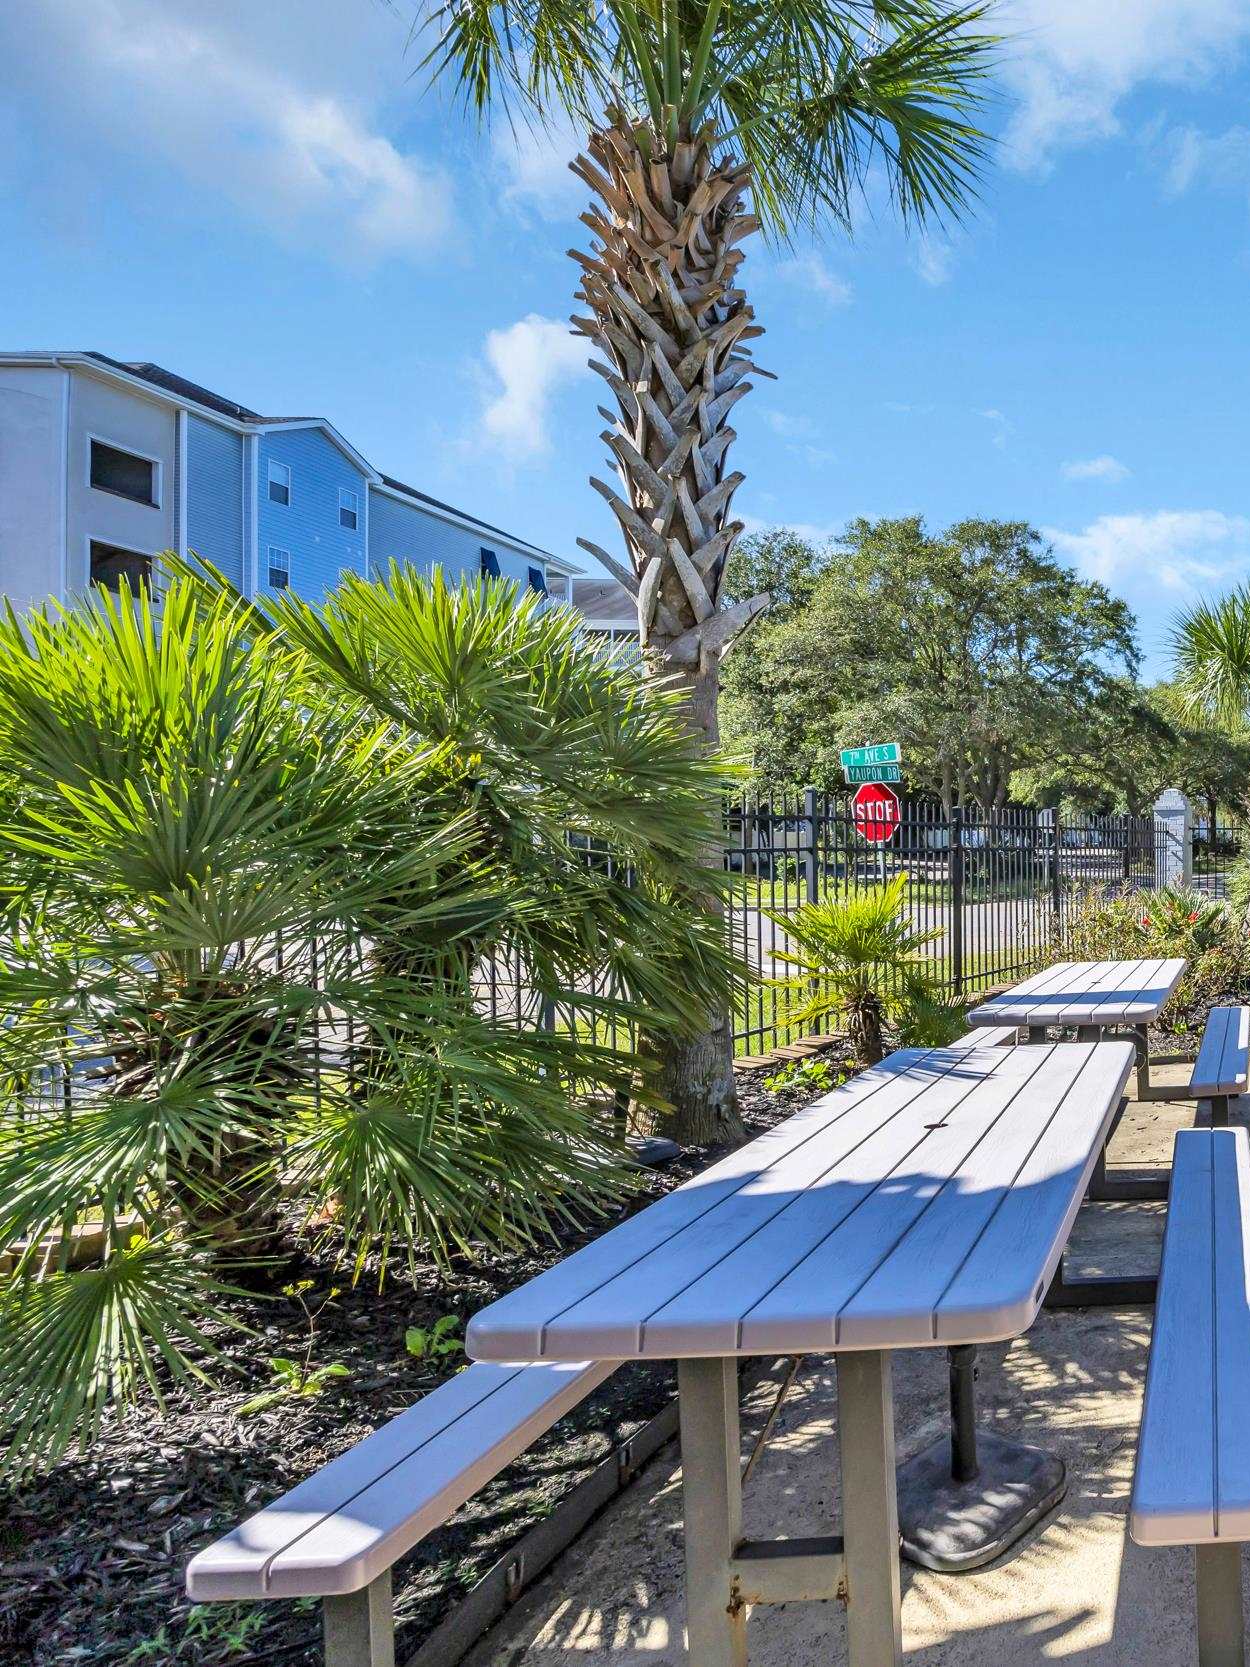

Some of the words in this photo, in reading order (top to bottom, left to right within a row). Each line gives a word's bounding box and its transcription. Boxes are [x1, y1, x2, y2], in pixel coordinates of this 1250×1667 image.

[864, 749, 881, 764] AVE
[882, 746, 889, 760] S
[850, 767, 882, 781] YAUPON
[887, 767, 898, 780] DR
[856, 800, 894, 825] STOP
